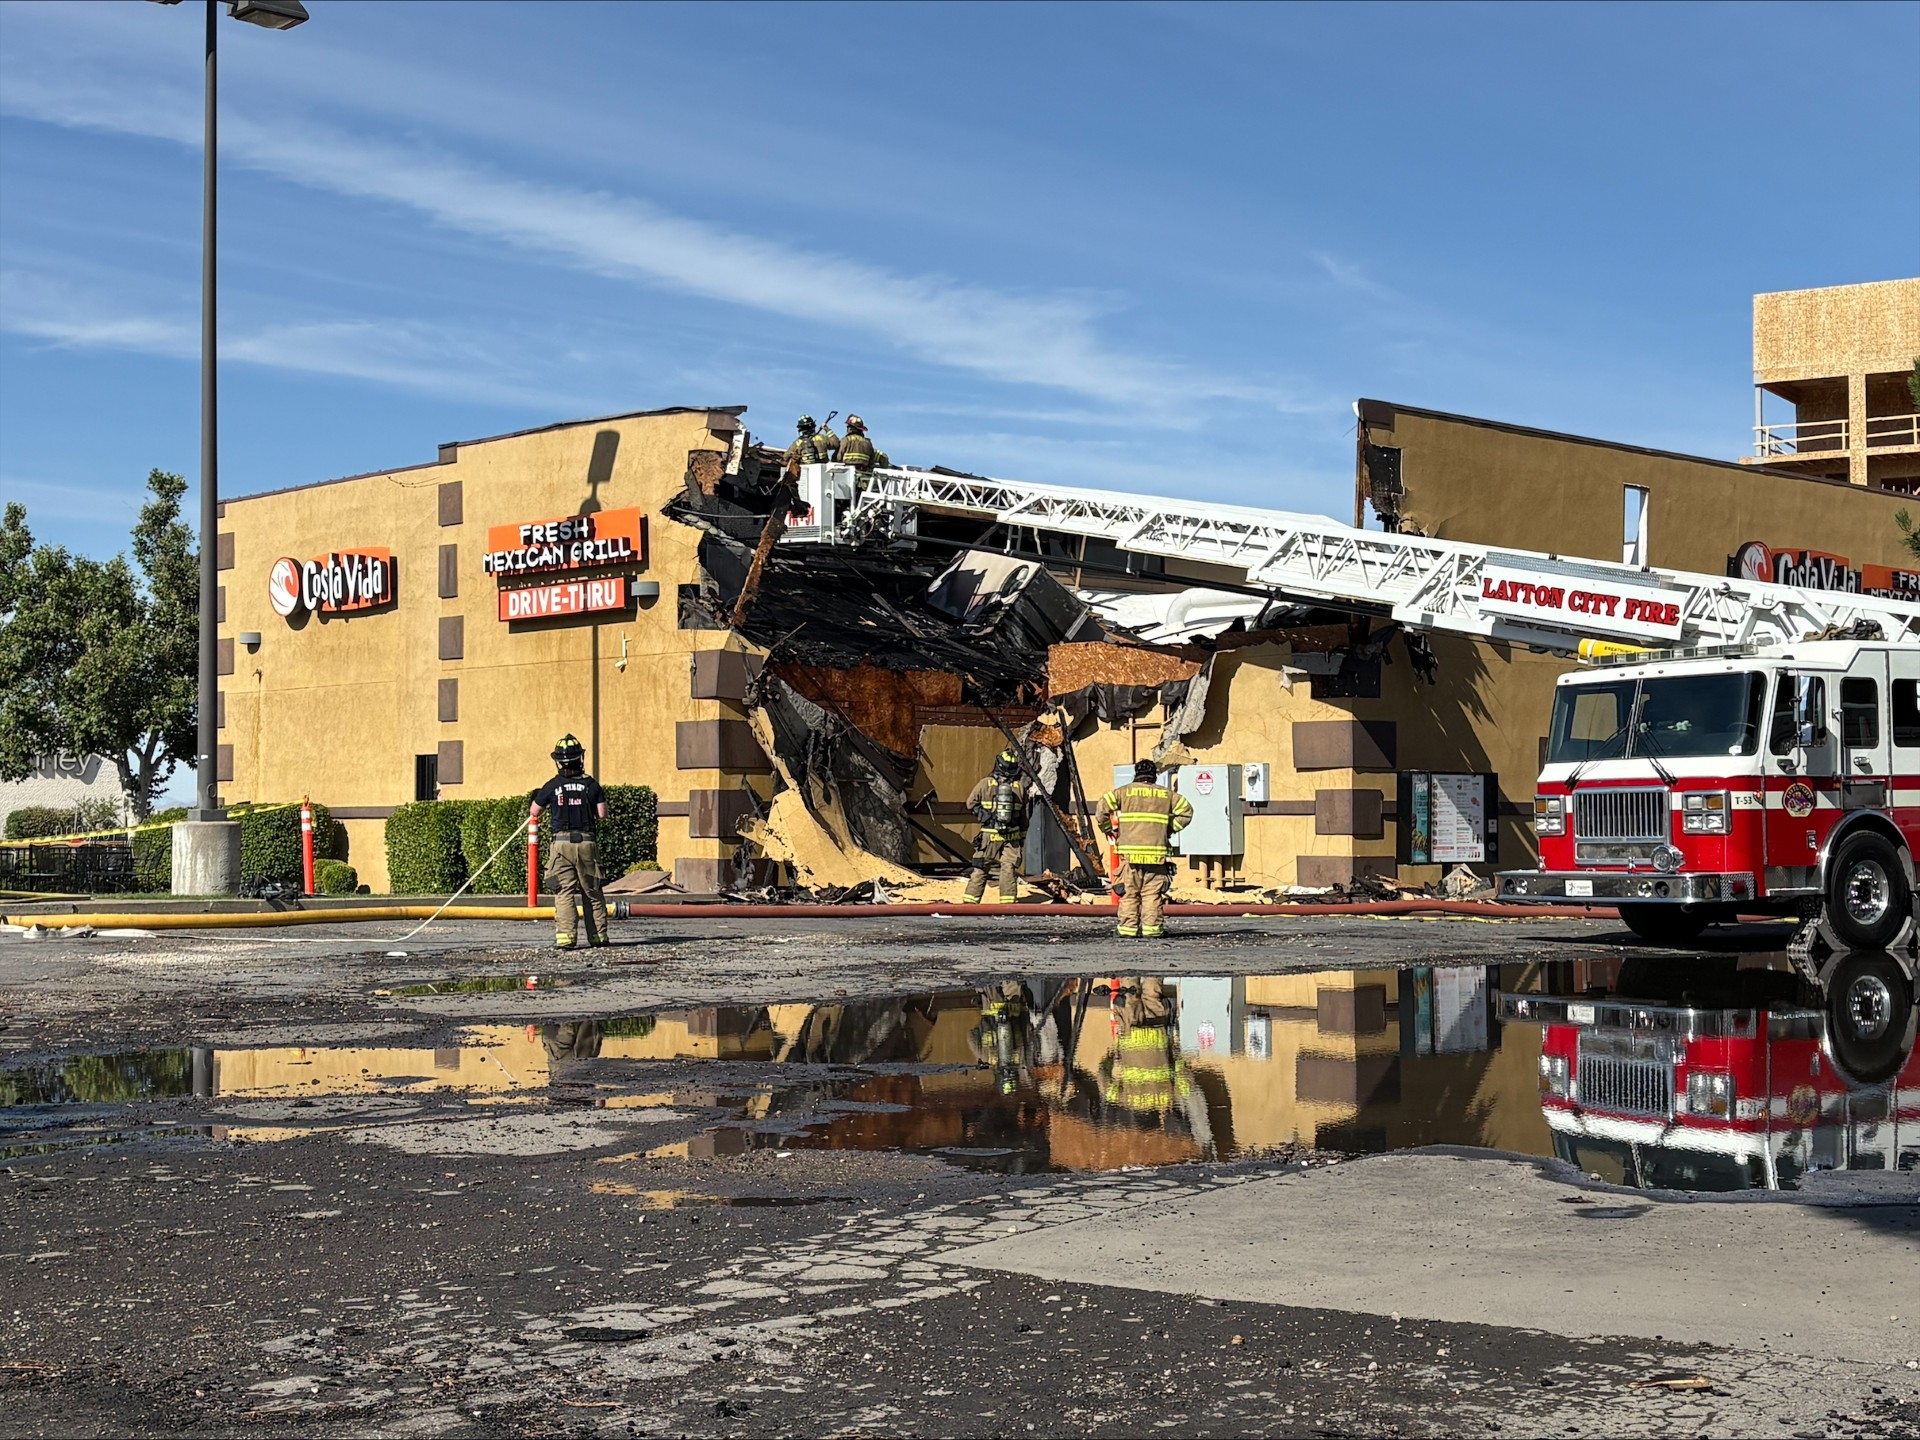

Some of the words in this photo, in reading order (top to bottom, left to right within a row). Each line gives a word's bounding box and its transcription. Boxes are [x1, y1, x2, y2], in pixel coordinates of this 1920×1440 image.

[519, 517, 589, 545] FRESH
[482, 543, 564, 572] MEXICAN
[570, 537, 631, 562] GRILL
[302, 552, 342, 610] Costa
[342, 553, 382, 604] Vida
[508, 580, 616, 617] DRIVE-THRU
[1481, 577, 1565, 609] LAYTON
[1568, 590, 1620, 617] CITY
[1624, 598, 1680, 626] FIRE
[1126, 787, 1152, 798] LAYTON
[1153, 788, 1168, 799] FIRE
[1735, 796, 1753, 805] T-53
[1129, 854, 1163, 864] MARTINEZ
